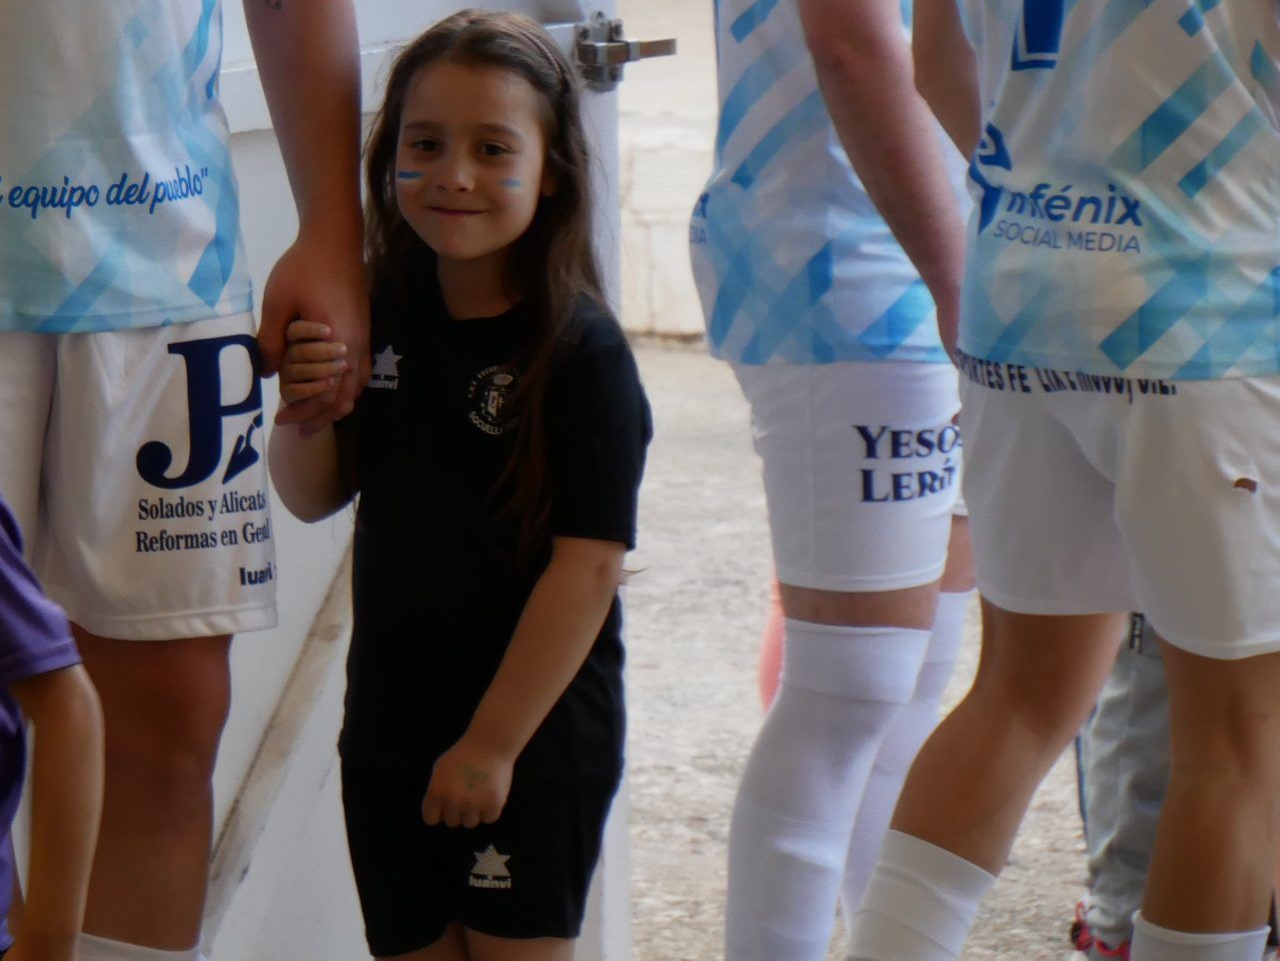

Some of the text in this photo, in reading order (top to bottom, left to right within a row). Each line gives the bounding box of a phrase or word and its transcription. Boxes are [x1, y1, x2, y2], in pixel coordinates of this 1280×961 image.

[8, 175, 99, 219] equipo
[106, 172, 150, 205] del
[993, 219, 1141, 254] SOCIAL MEDIA
[852, 425, 962, 459] YESO
[138, 496, 205, 521] Solados
[208, 499, 218, 521] y
[136, 529, 217, 552] Reformas
[221, 530, 238, 546] en
